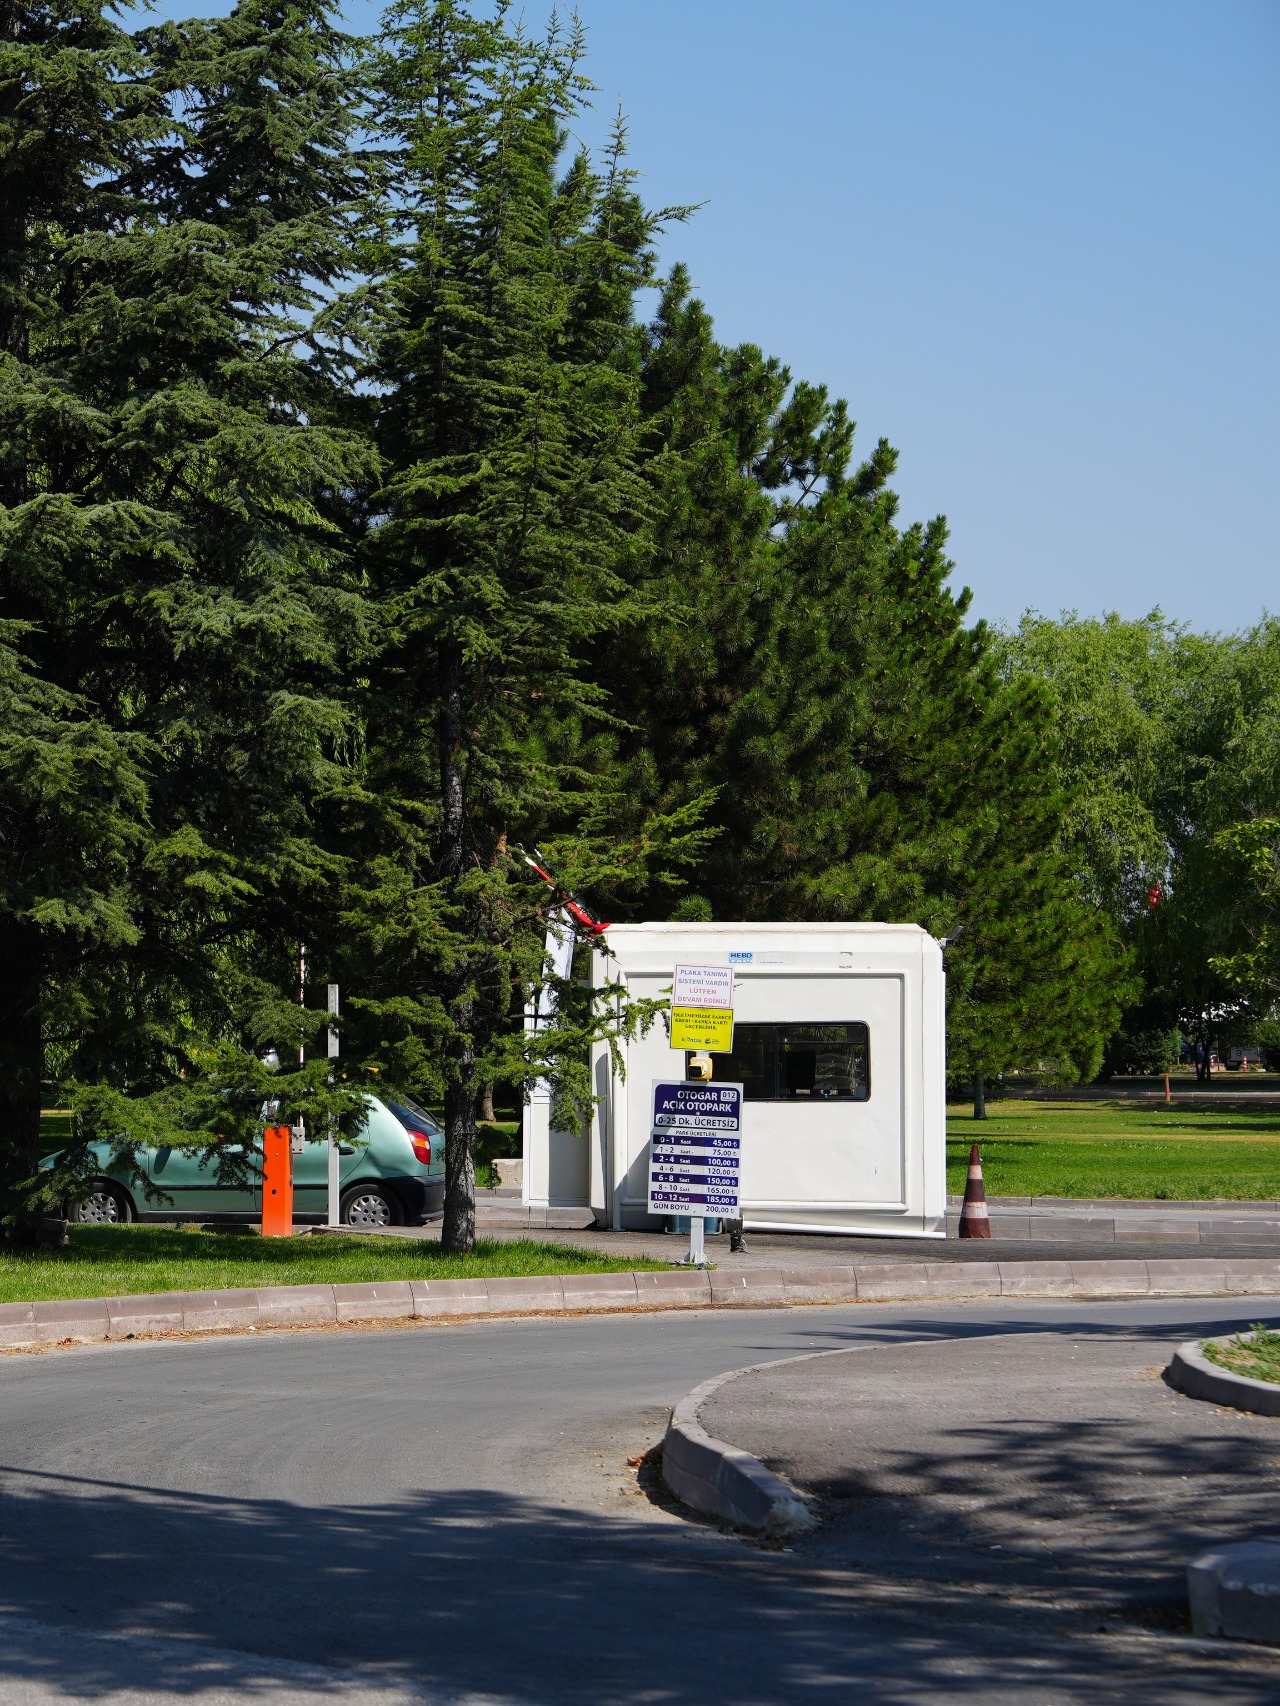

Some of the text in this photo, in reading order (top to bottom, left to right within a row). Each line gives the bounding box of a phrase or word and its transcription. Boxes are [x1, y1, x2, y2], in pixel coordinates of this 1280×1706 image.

[678, 1091, 717, 1100] OTOGAR
[663, 1101, 732, 1112] AÇIK OTOPARK
[695, 1117, 735, 1128] ÜCRETSİZ
